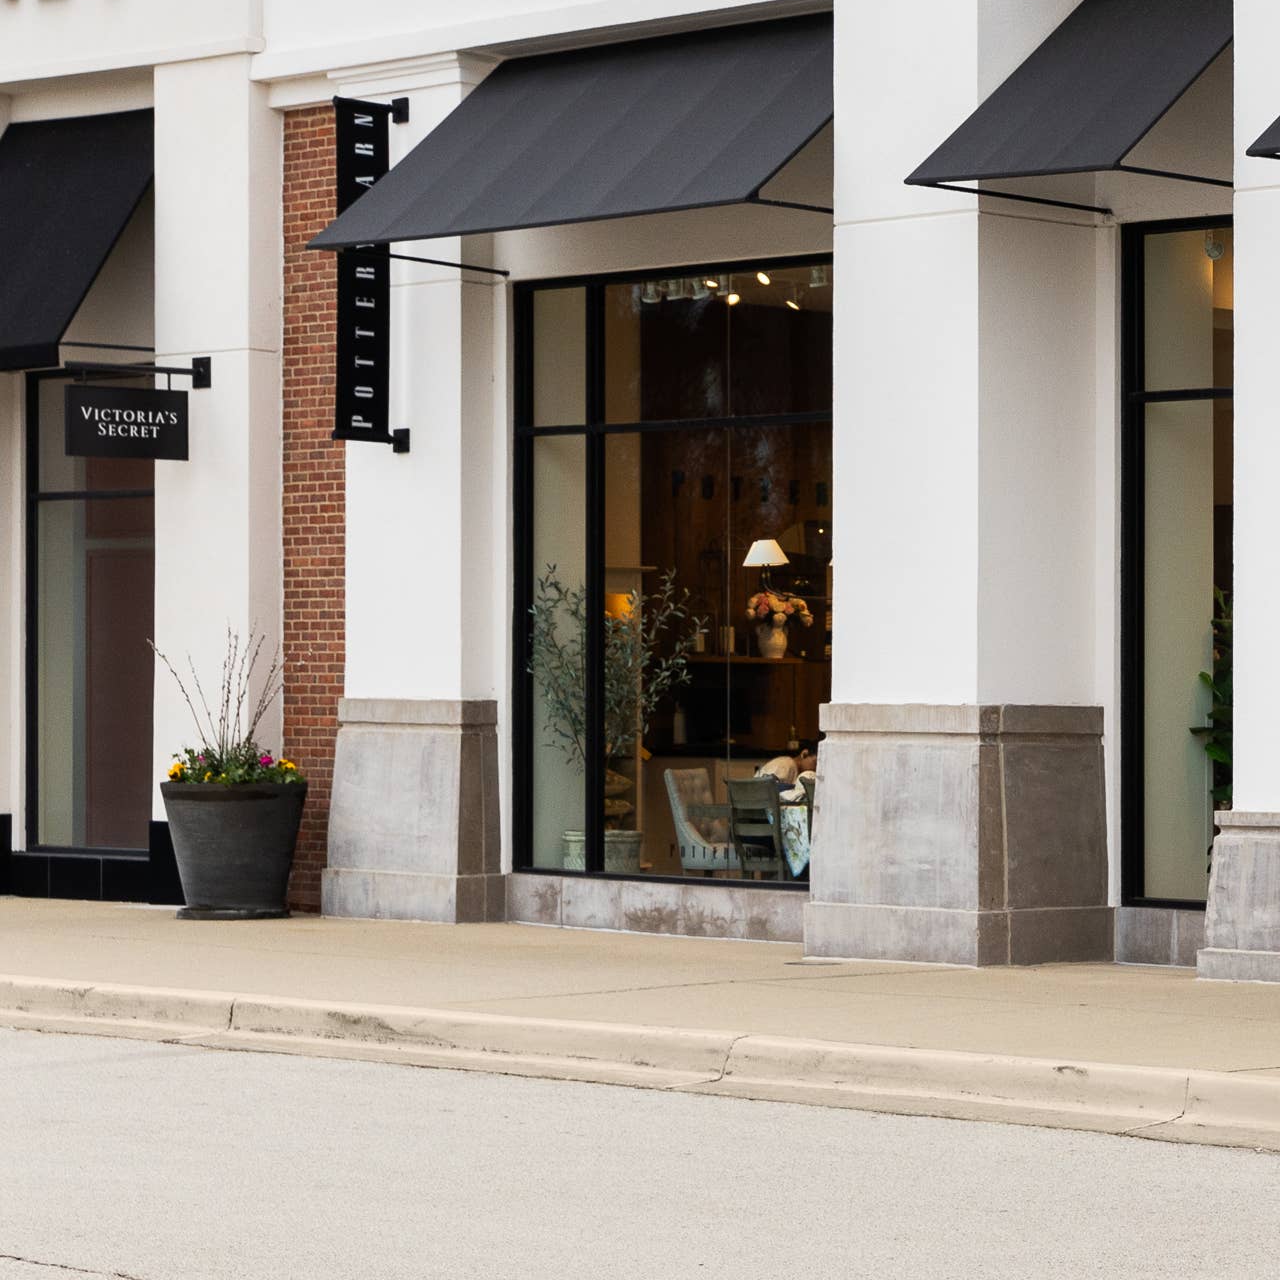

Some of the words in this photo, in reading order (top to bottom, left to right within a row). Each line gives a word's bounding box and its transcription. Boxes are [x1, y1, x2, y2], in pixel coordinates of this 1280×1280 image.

[351, 243, 376, 428] POTTER
[81, 406, 178, 424] VICTORIA'S
[98, 422, 160, 438] SECRET
